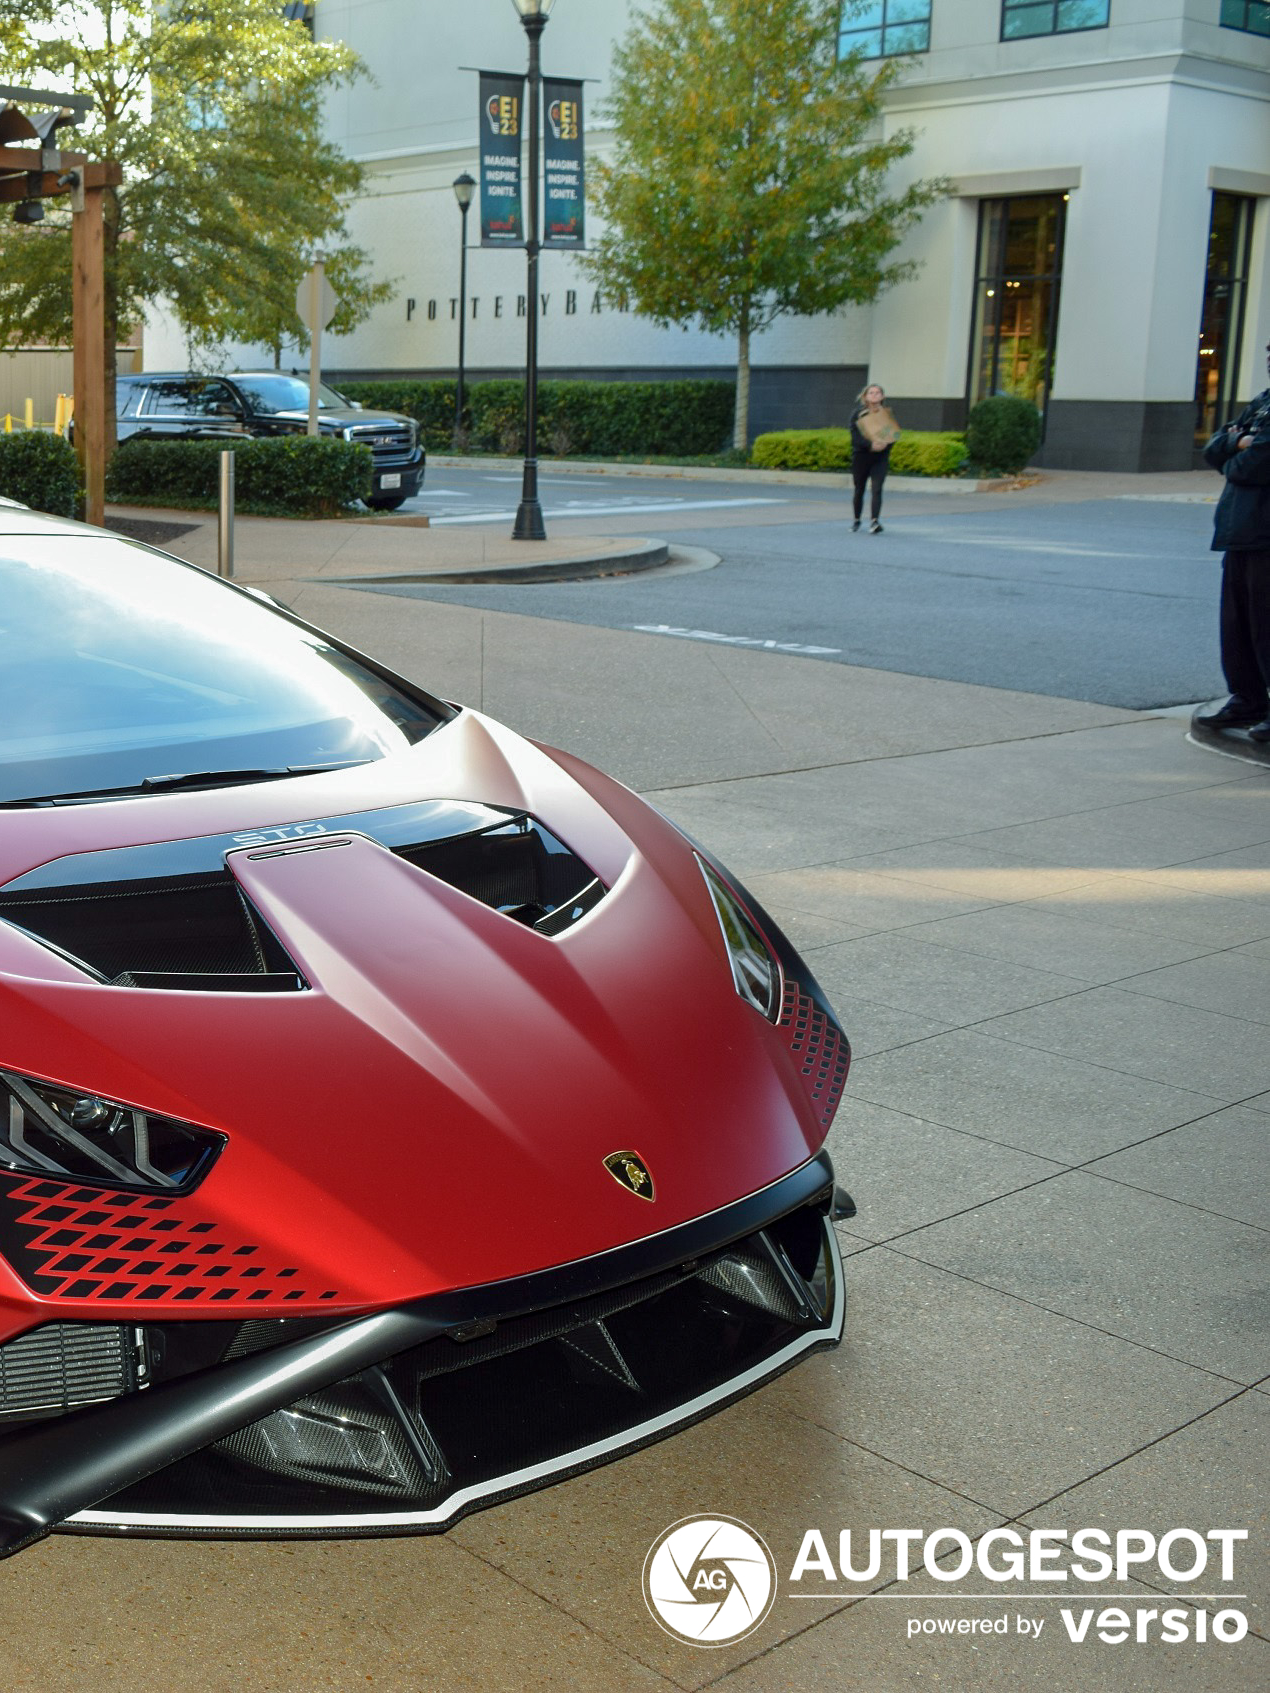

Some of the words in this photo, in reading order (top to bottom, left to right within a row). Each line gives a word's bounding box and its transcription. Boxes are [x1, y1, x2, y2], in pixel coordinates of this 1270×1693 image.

[500, 119, 518, 136] 23
[560, 123, 578, 139] 23
[484, 156, 519, 167] IMAGINE.
[485, 171, 518, 182] INSPIRE.
[232, 823, 327, 845] STO
